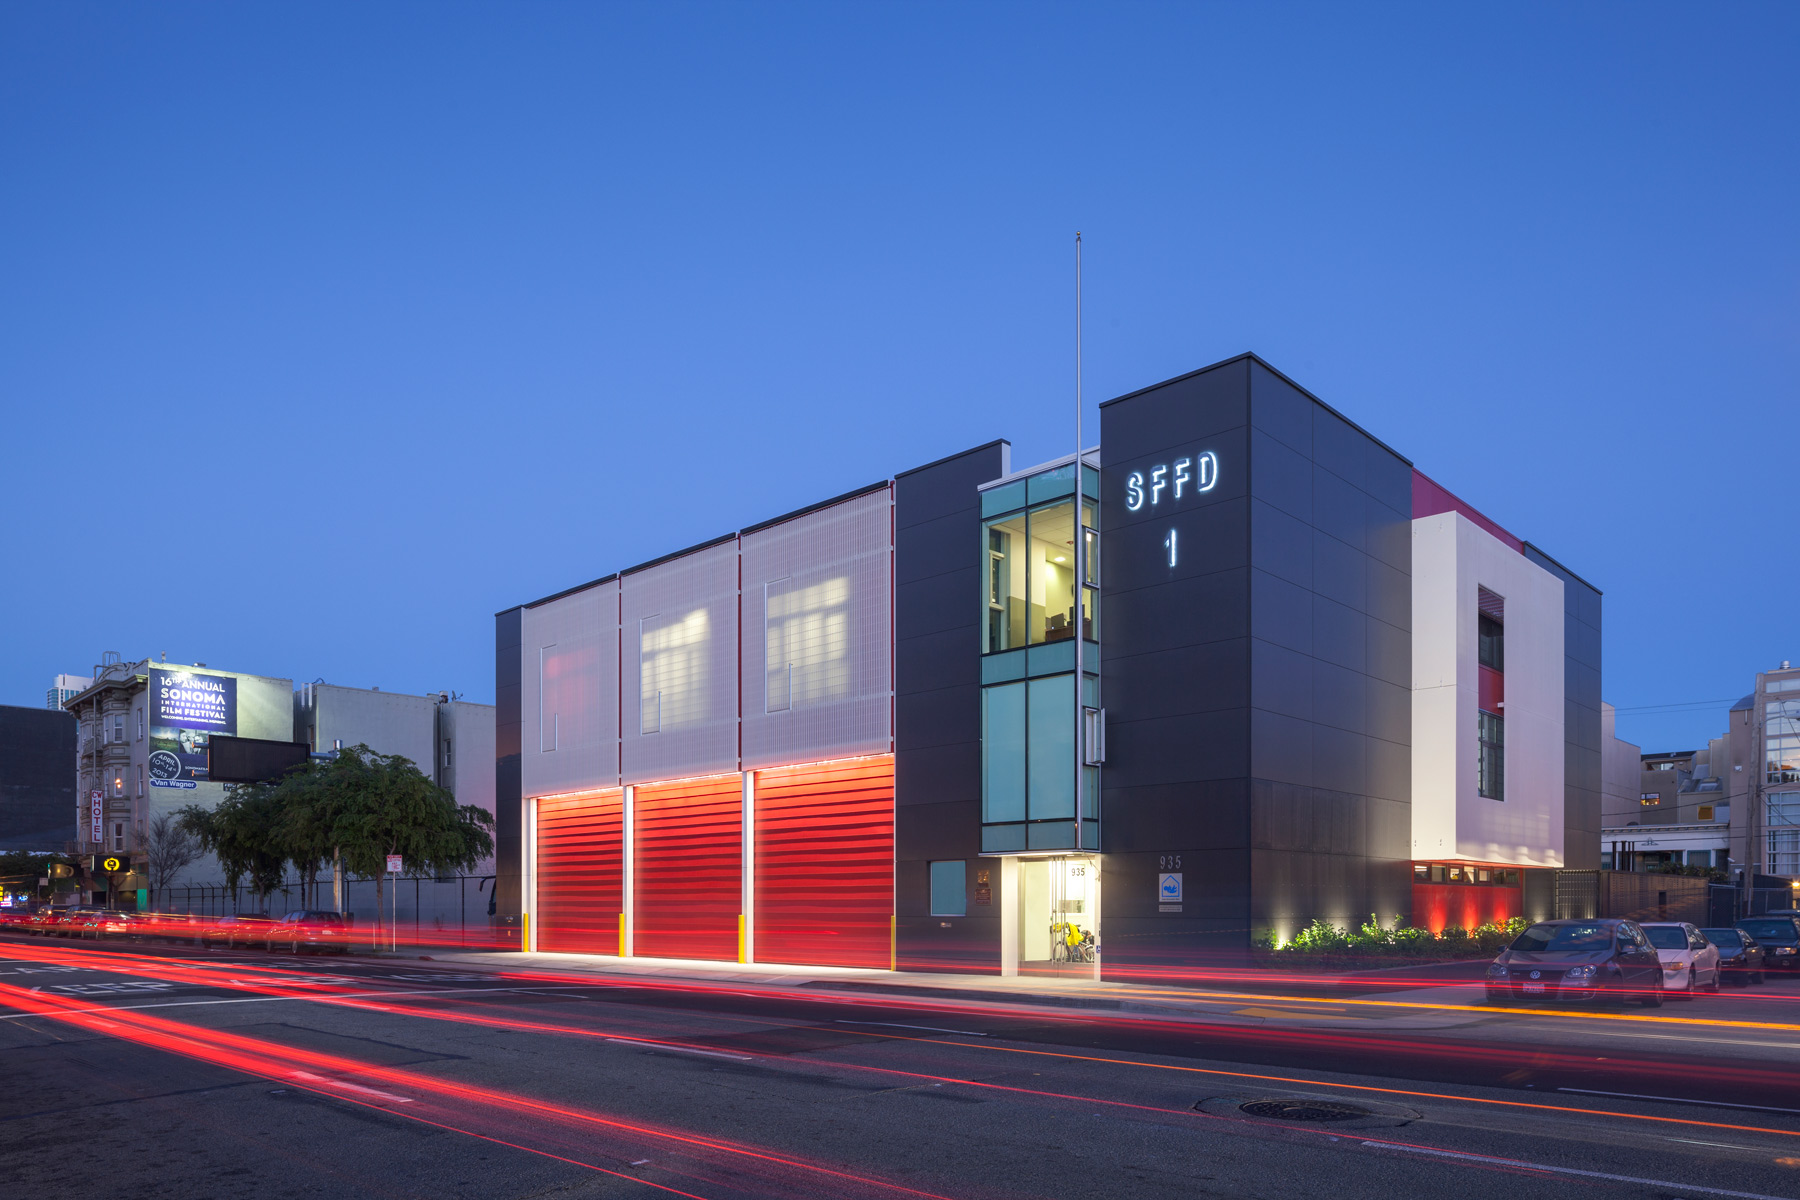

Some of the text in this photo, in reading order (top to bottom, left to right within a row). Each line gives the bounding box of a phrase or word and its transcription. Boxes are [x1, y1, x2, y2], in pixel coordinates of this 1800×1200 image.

[1125, 451, 1218, 511] SFFD
[1164, 528, 1177, 567] 1
[181, 680, 225, 692] ANNUAL
[161, 688, 225, 704] SONOMA
[161, 700, 225, 711] INTERNATIONAL
[161, 706, 225, 719] FILM FESTIVAL
[158, 754, 175, 766] APRIL
[152, 767, 168, 778] 2013
[169, 780, 195, 788] Wagner
[93, 800, 101, 842] HOTEL
[1160, 855, 1181, 869] 935
[1071, 867, 1085, 876] 935
